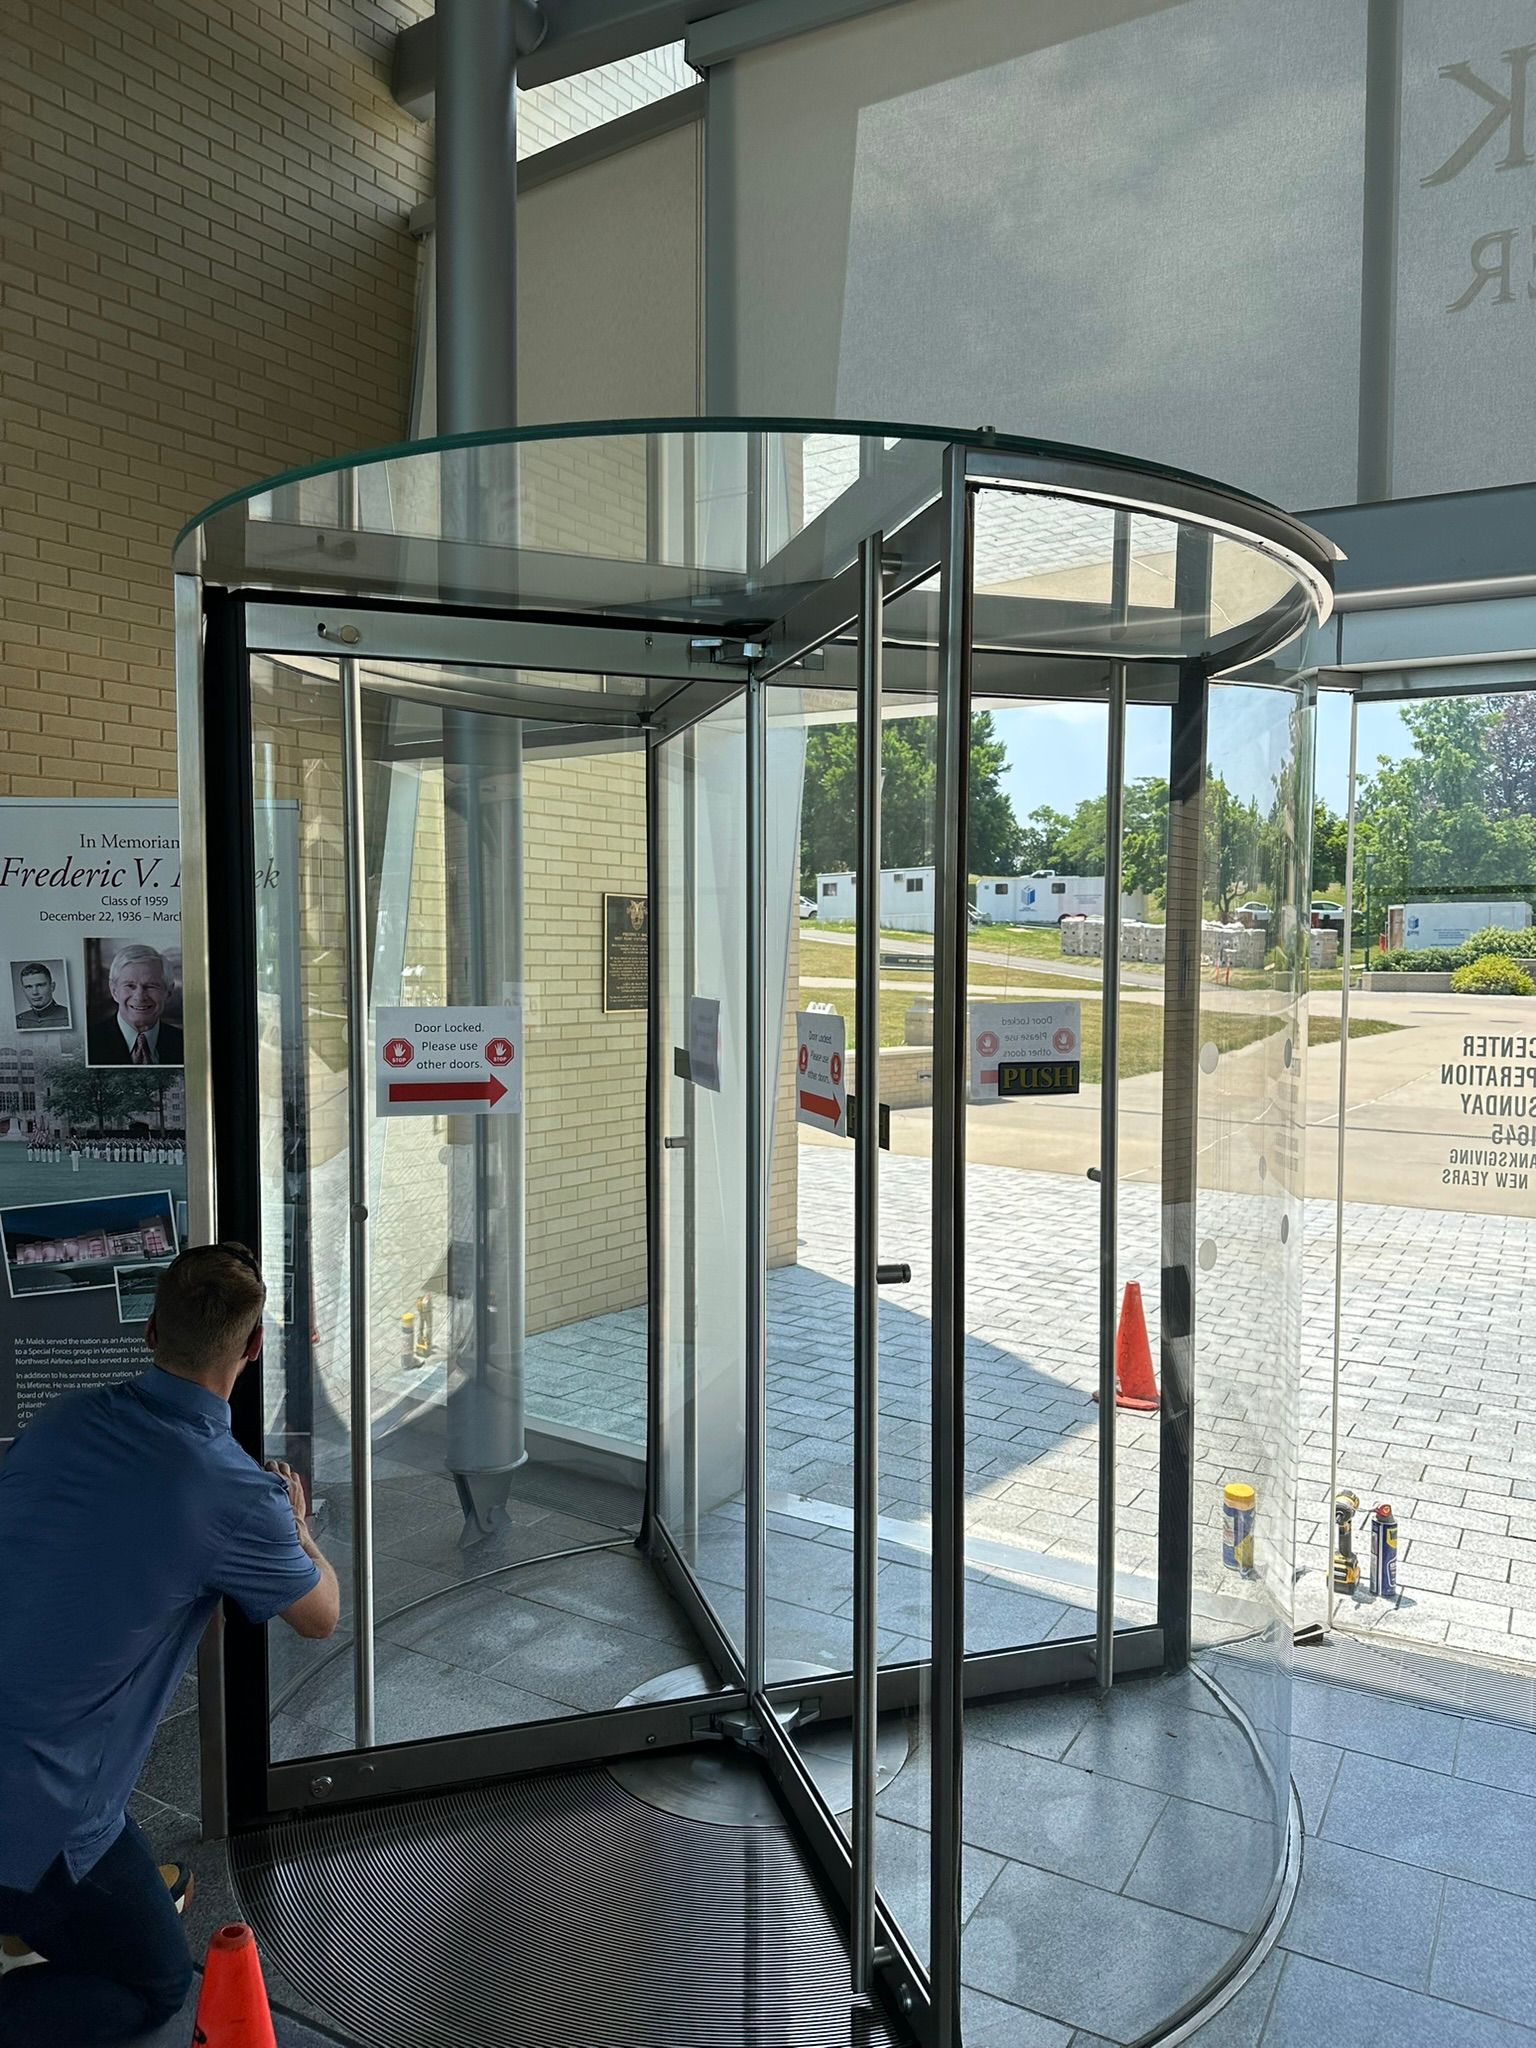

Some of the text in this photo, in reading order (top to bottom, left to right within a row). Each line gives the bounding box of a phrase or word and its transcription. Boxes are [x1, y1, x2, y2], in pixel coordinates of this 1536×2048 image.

[79, 834, 96, 849] In
[0, 856, 126, 888] Frederic
[134, 858, 162, 888] V.
[101, 895, 169, 906] Class of 1959
[40, 911, 95, 922] December
[98, 911, 114, 923] 22,
[118, 911, 142, 922] 1936
[414, 1022, 485, 1033] Door Locked.
[421, 1041, 478, 1051] Please use
[416, 1059, 483, 1070] other doors.
[1003, 1066, 1074, 1089] PUSH
[73, 1348, 93, 1357] group
[74, 1357, 86, 1365] and
[69, 1371, 90, 1379] service
